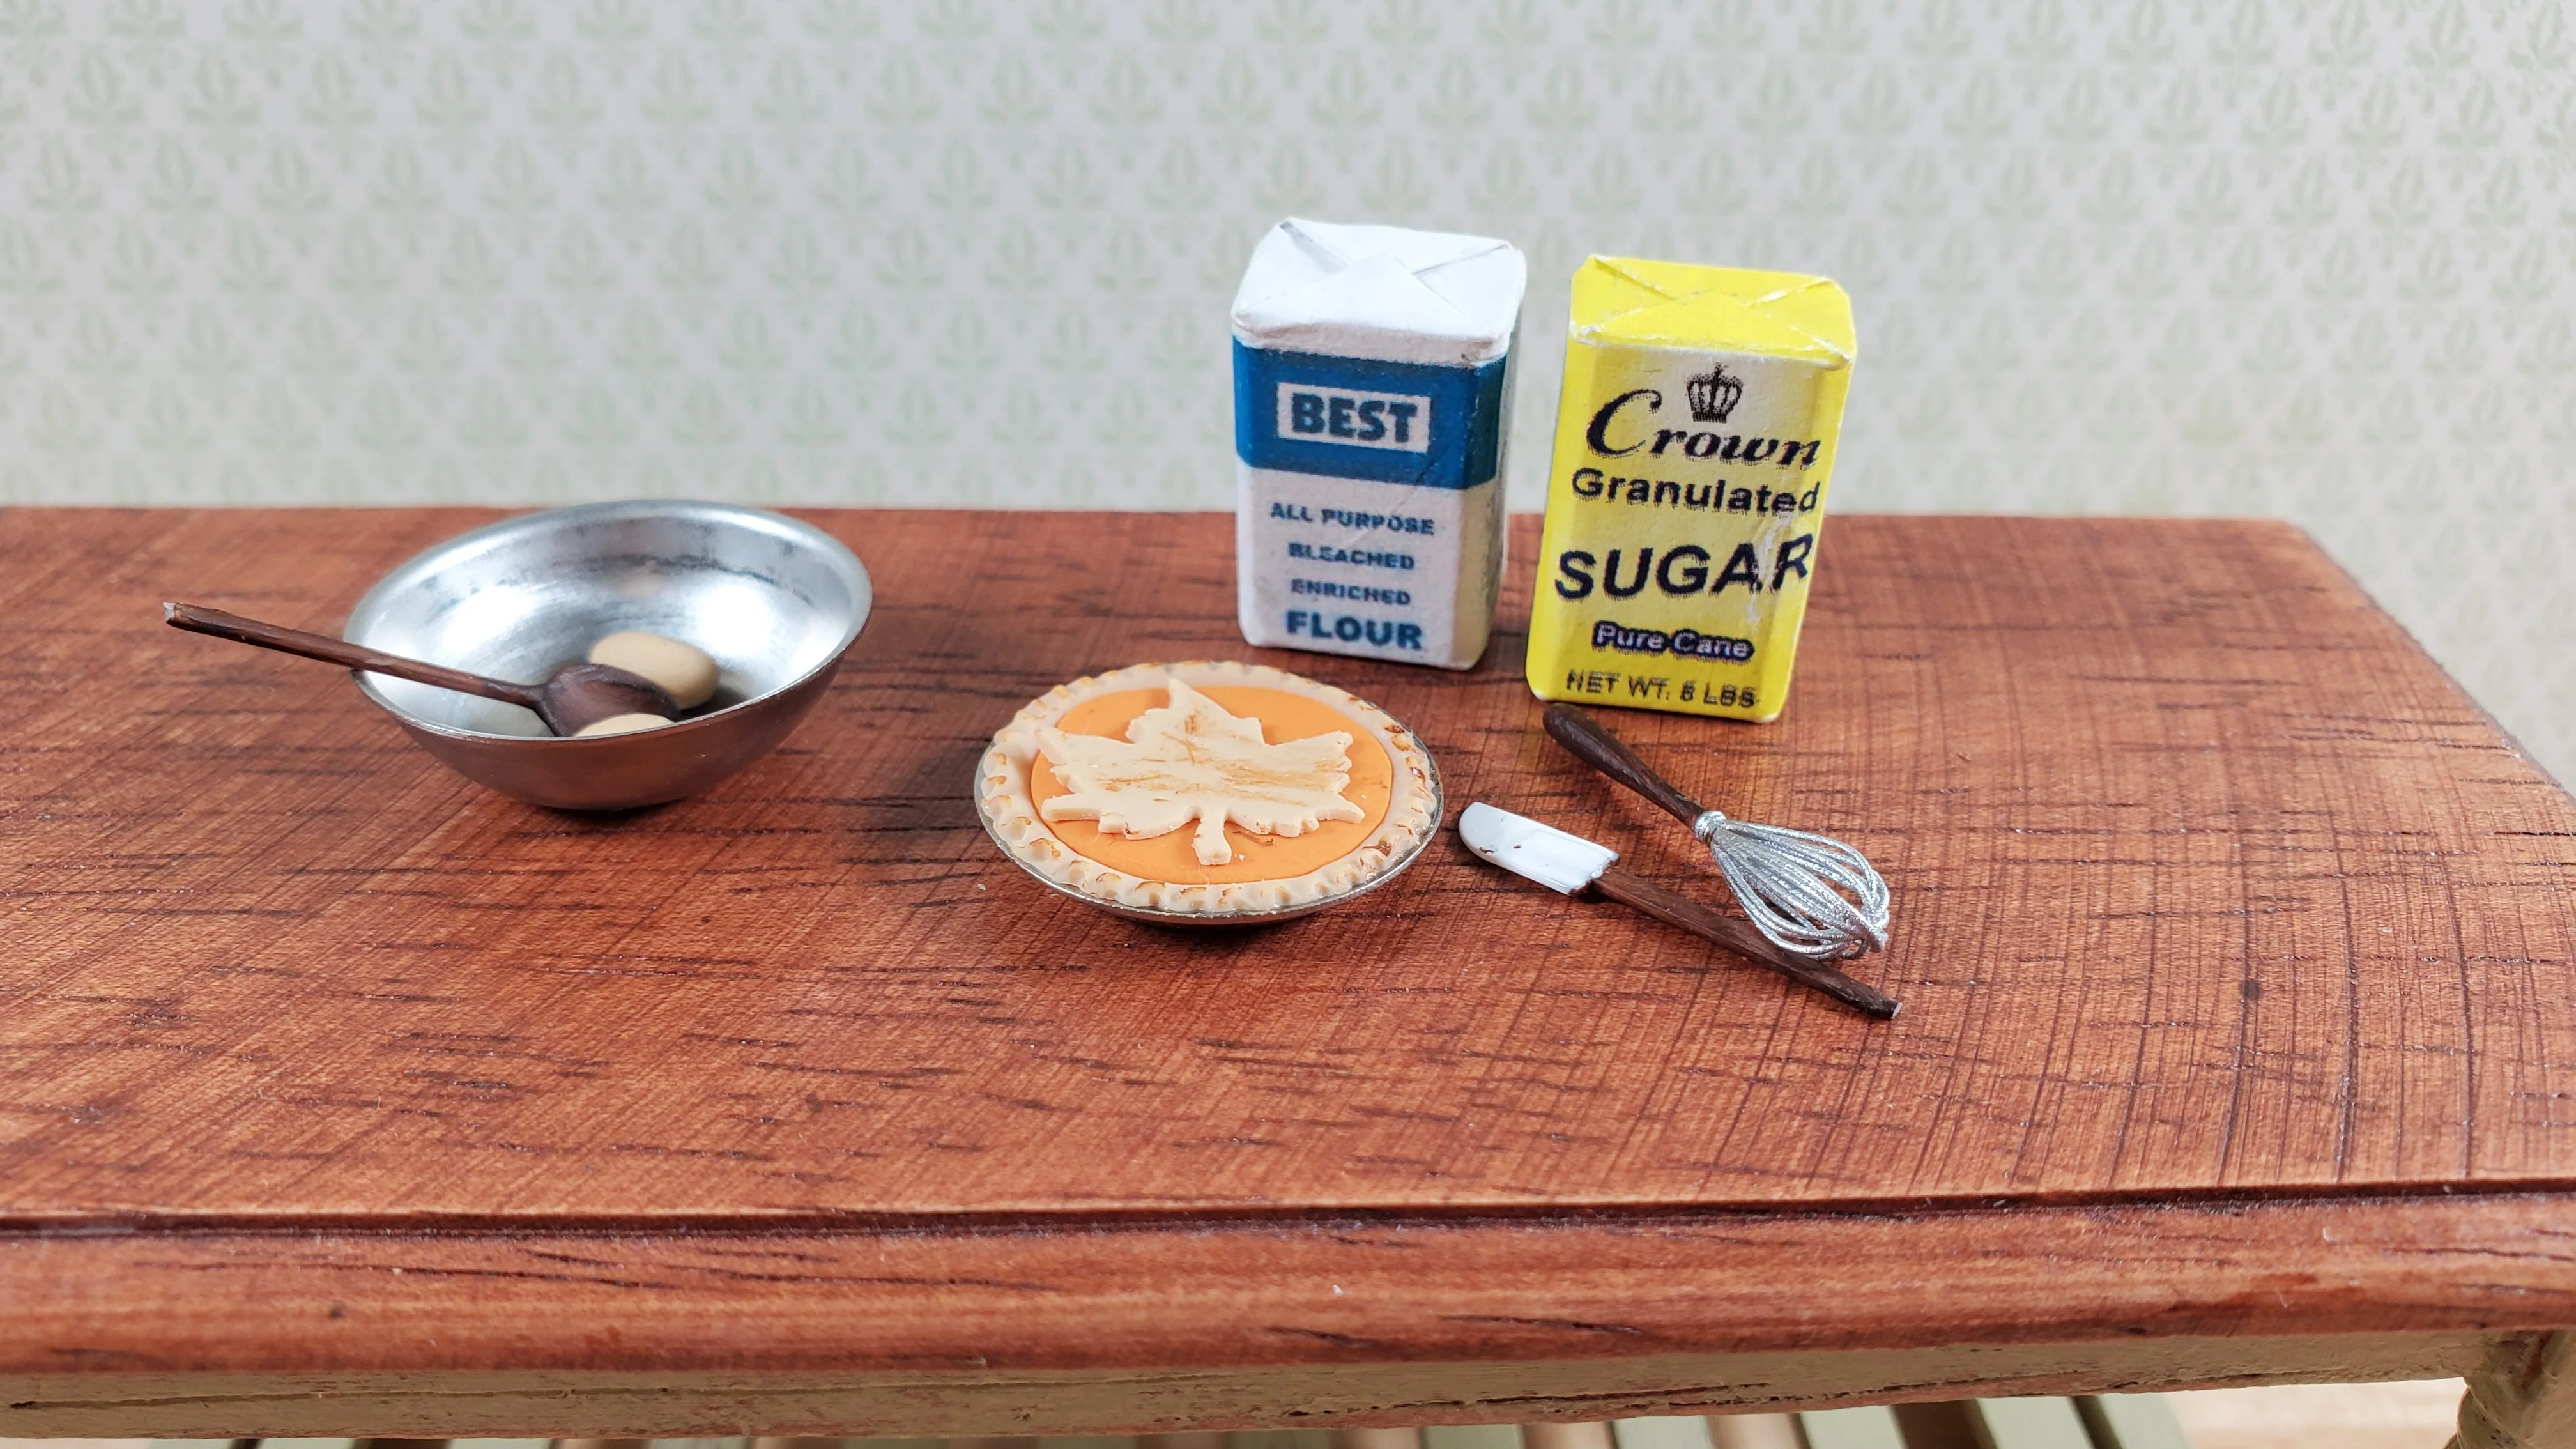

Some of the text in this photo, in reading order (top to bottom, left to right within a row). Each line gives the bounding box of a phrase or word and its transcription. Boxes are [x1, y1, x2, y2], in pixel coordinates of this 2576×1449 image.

[1291, 392, 1418, 443] BEST
[1586, 389, 1821, 470] Crown
[1572, 467, 1821, 517] Granulated
[1271, 502, 1435, 535] ALL PURPOSE
[1288, 542, 1415, 570] BLEACHED
[1554, 533, 1813, 600] SUGAR
[1291, 578, 1411, 606] ENRICHED
[1285, 610, 1422, 650] FLOUR
[1597, 623, 1750, 659] Pure Cane
[1565, 670, 1620, 694] NET
[1628, 676, 1670, 700] WT.
